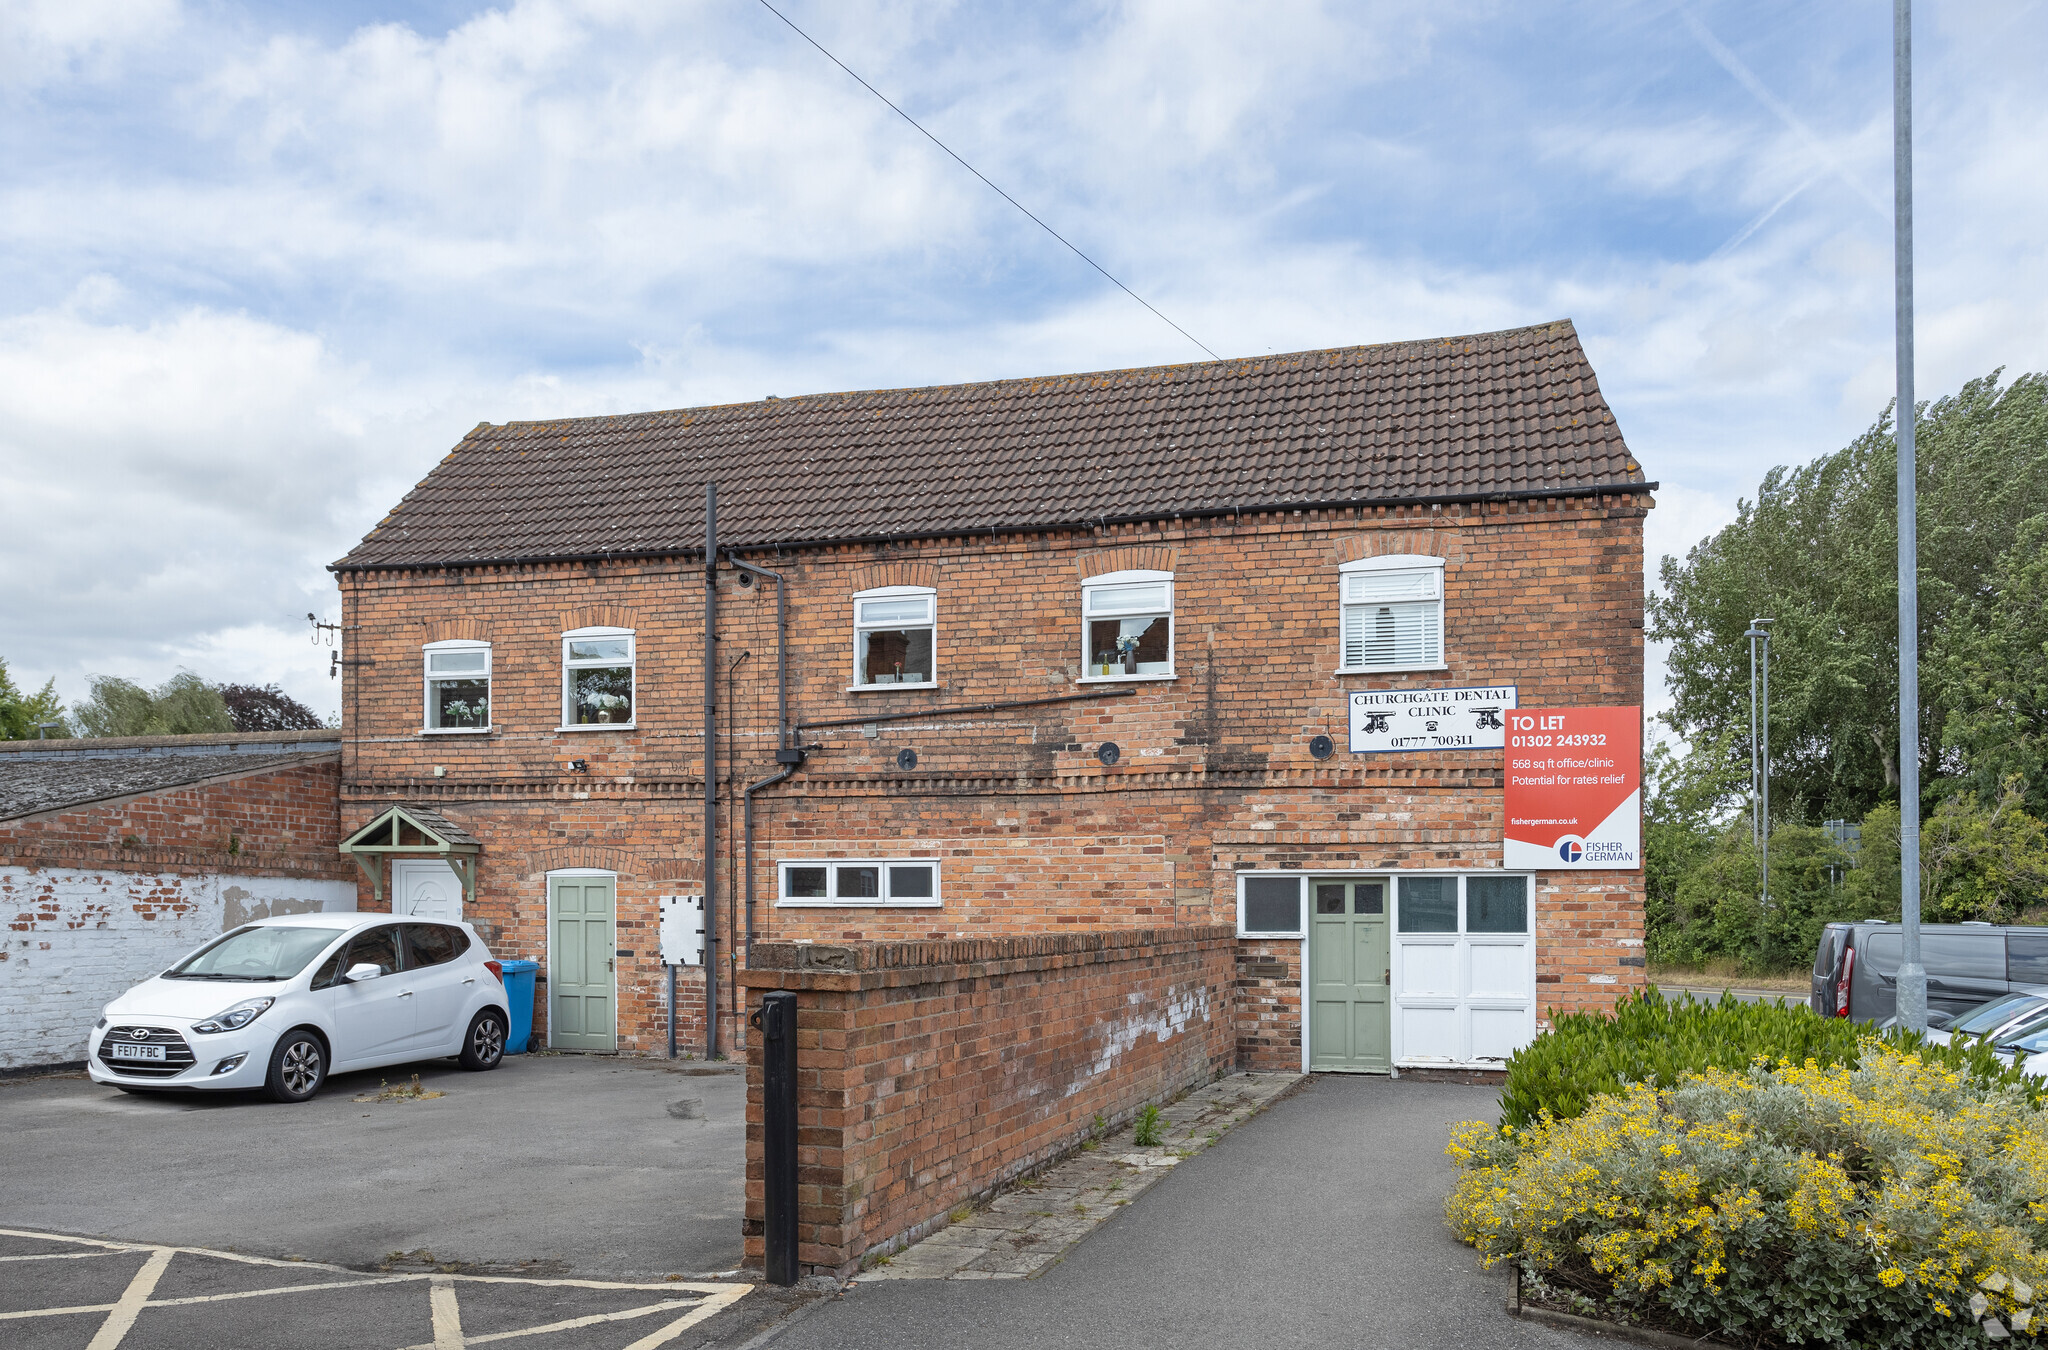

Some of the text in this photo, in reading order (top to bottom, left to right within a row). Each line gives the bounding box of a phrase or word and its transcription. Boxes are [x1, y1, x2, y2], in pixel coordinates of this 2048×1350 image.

[1355, 690, 1510, 706] CHURCHGATE DENTAL
[1408, 706, 1456, 718] CLINIC
[1512, 716, 1565, 730] TO LET
[1391, 735, 1473, 747] 01777 700311
[1512, 734, 1606, 747] 01302 243932
[1512, 758, 1614, 770] 568 sq ft office/clinic
[1512, 774, 1625, 785] Potential for rates relief
[1511, 818, 1578, 826] fishergerman.co.uk
[1586, 842, 1622, 851] FISHER
[1586, 852, 1633, 861] GERMAN
[118, 1046, 159, 1058] FE17 FBC
